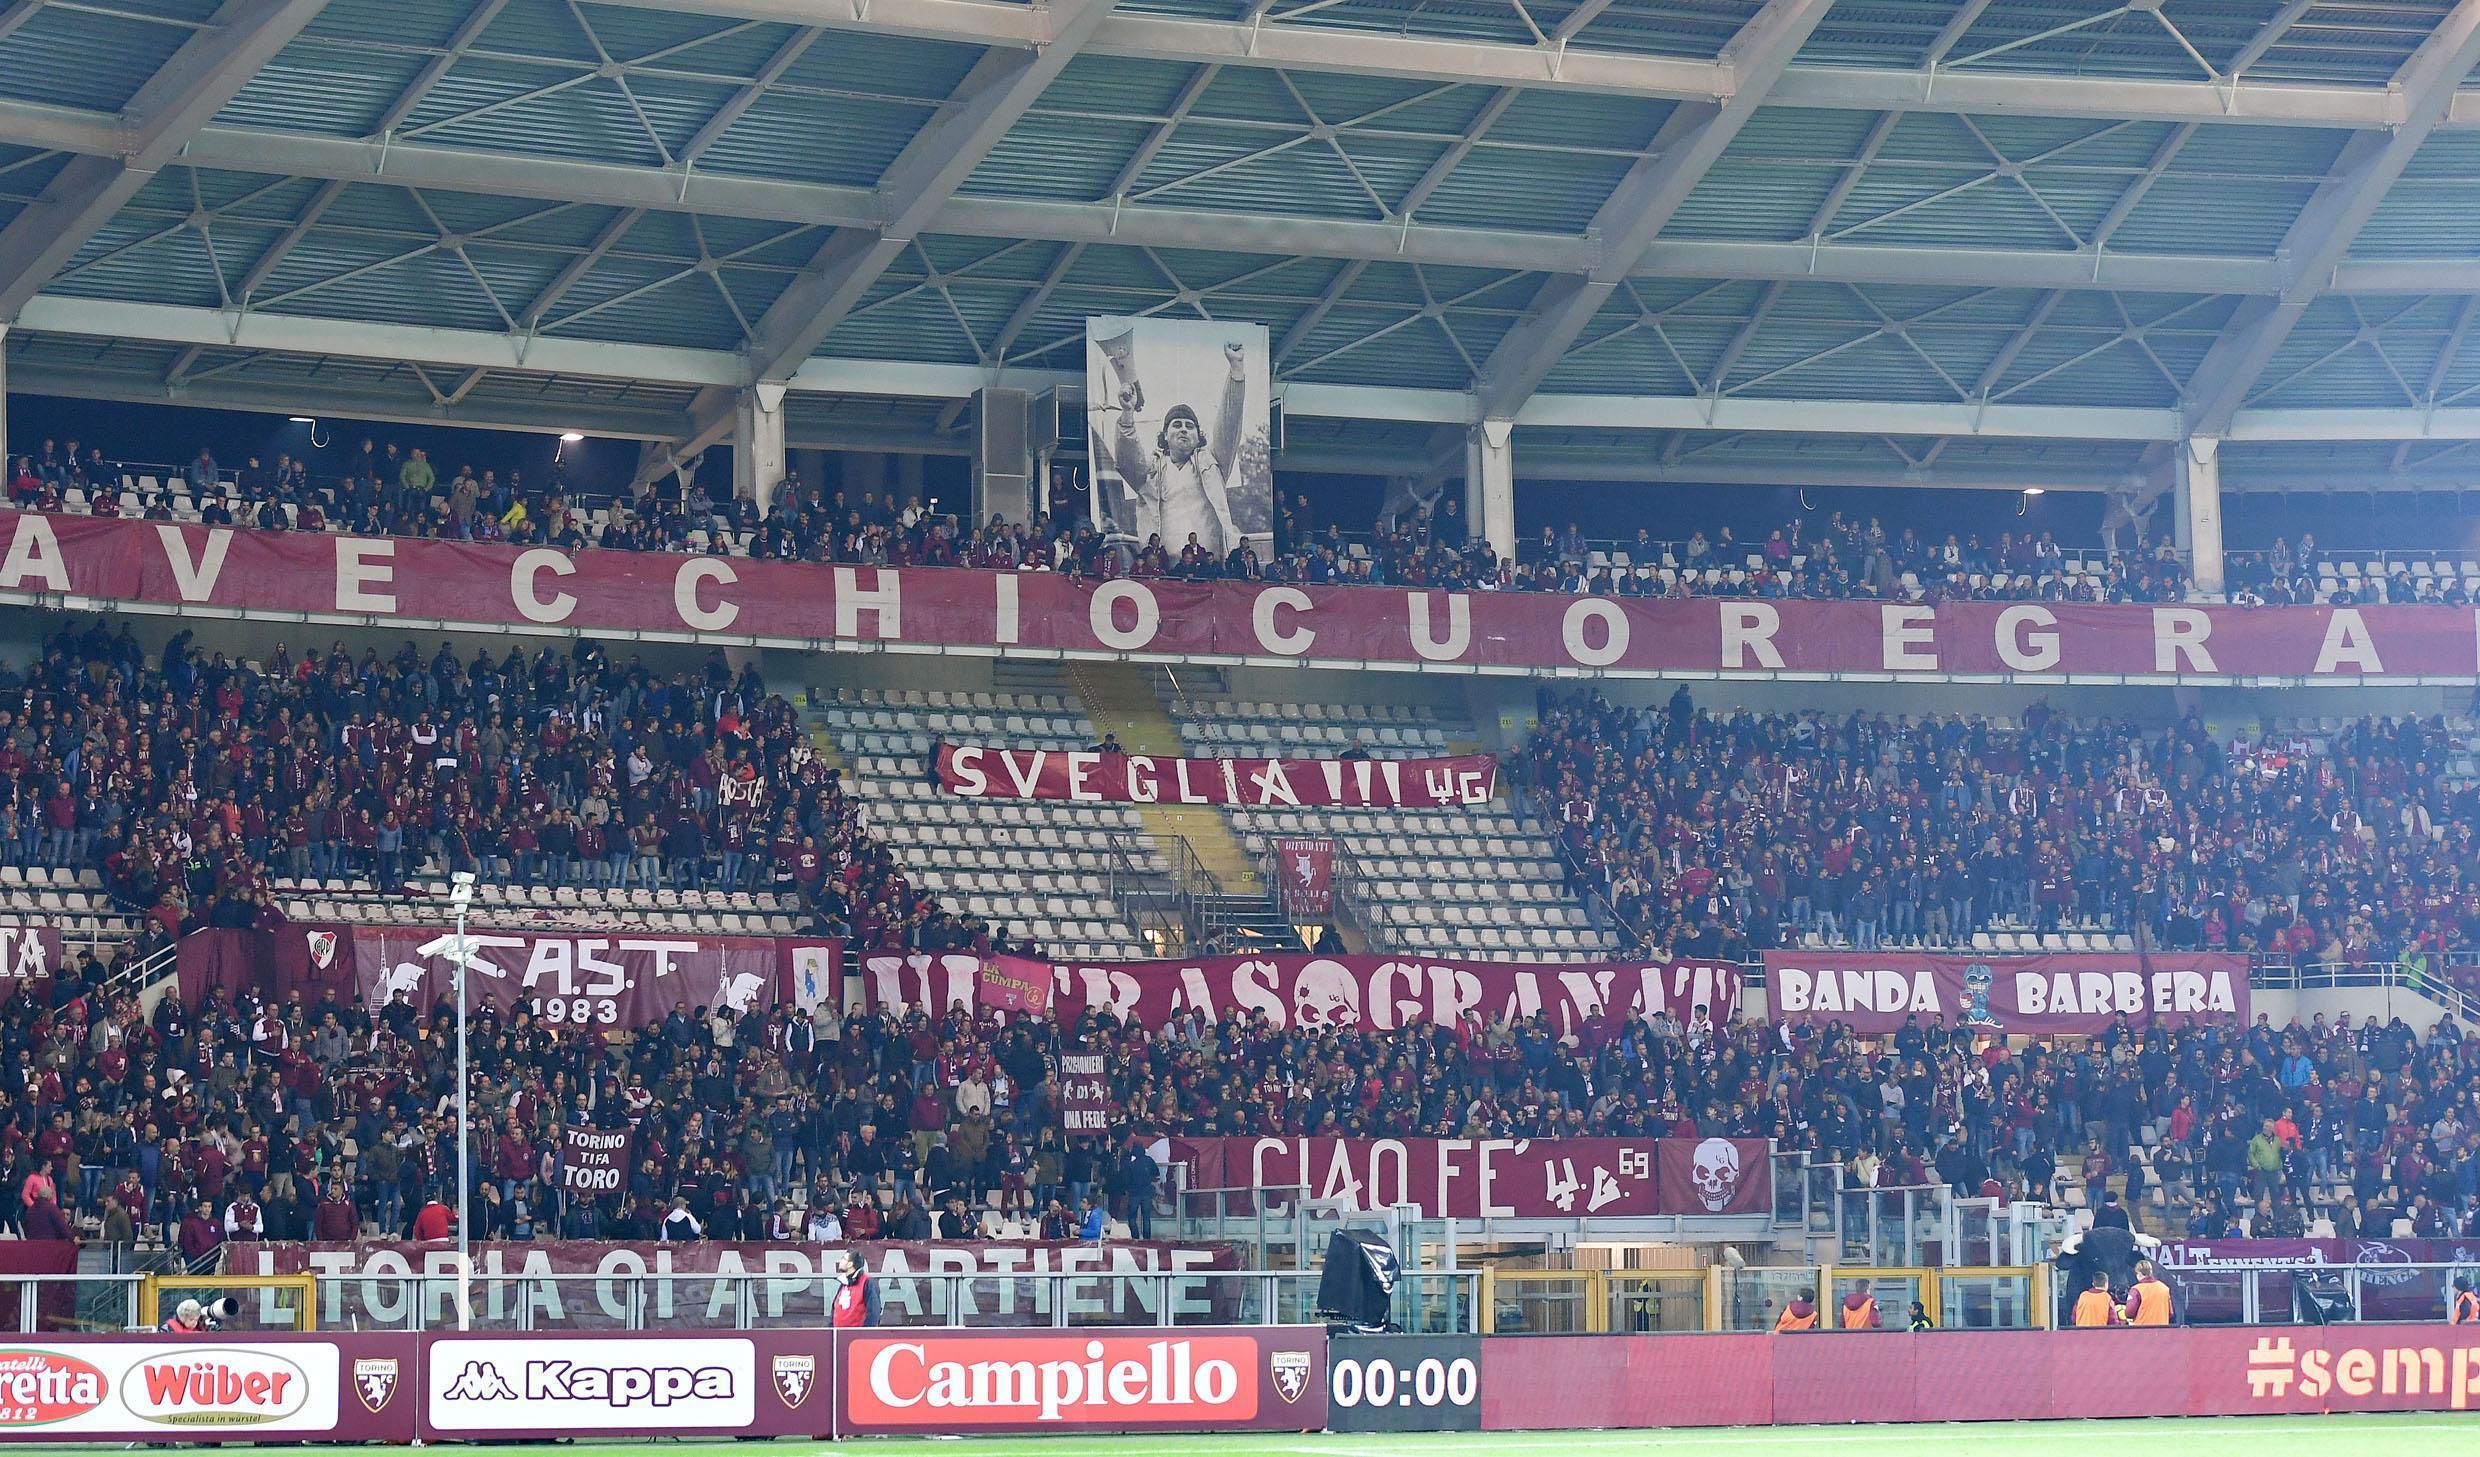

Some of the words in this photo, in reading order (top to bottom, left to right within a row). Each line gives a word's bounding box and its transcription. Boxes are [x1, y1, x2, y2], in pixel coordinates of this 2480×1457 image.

[718, 773, 765, 807] AOSTA
[1779, 969, 1941, 1012] BANDA
[2016, 971, 2236, 1014] BARBERA
[532, 999, 619, 1024] 1983
[1076, 1085, 1089, 1100] DI
[1064, 1110, 1082, 1129] UNA
[1082, 1110, 1107, 1129] FEDE
[567, 1129, 625, 1149] TORINO
[580, 1151, 610, 1166] TIFA
[1618, 1147, 1649, 1180] 69
[563, 1164, 620, 1189] TORO
[778, 1360, 811, 1369] TORINO
[1276, 1356, 1307, 1365] TORINO
[143, 1362, 292, 1405] Wüber
[526, 1361, 735, 1407] Kappa
[869, 1340, 1238, 1420] Campiello
[1332, 1358, 1478, 1407] 00:00
[167, 1414, 215, 1424] Specialista
